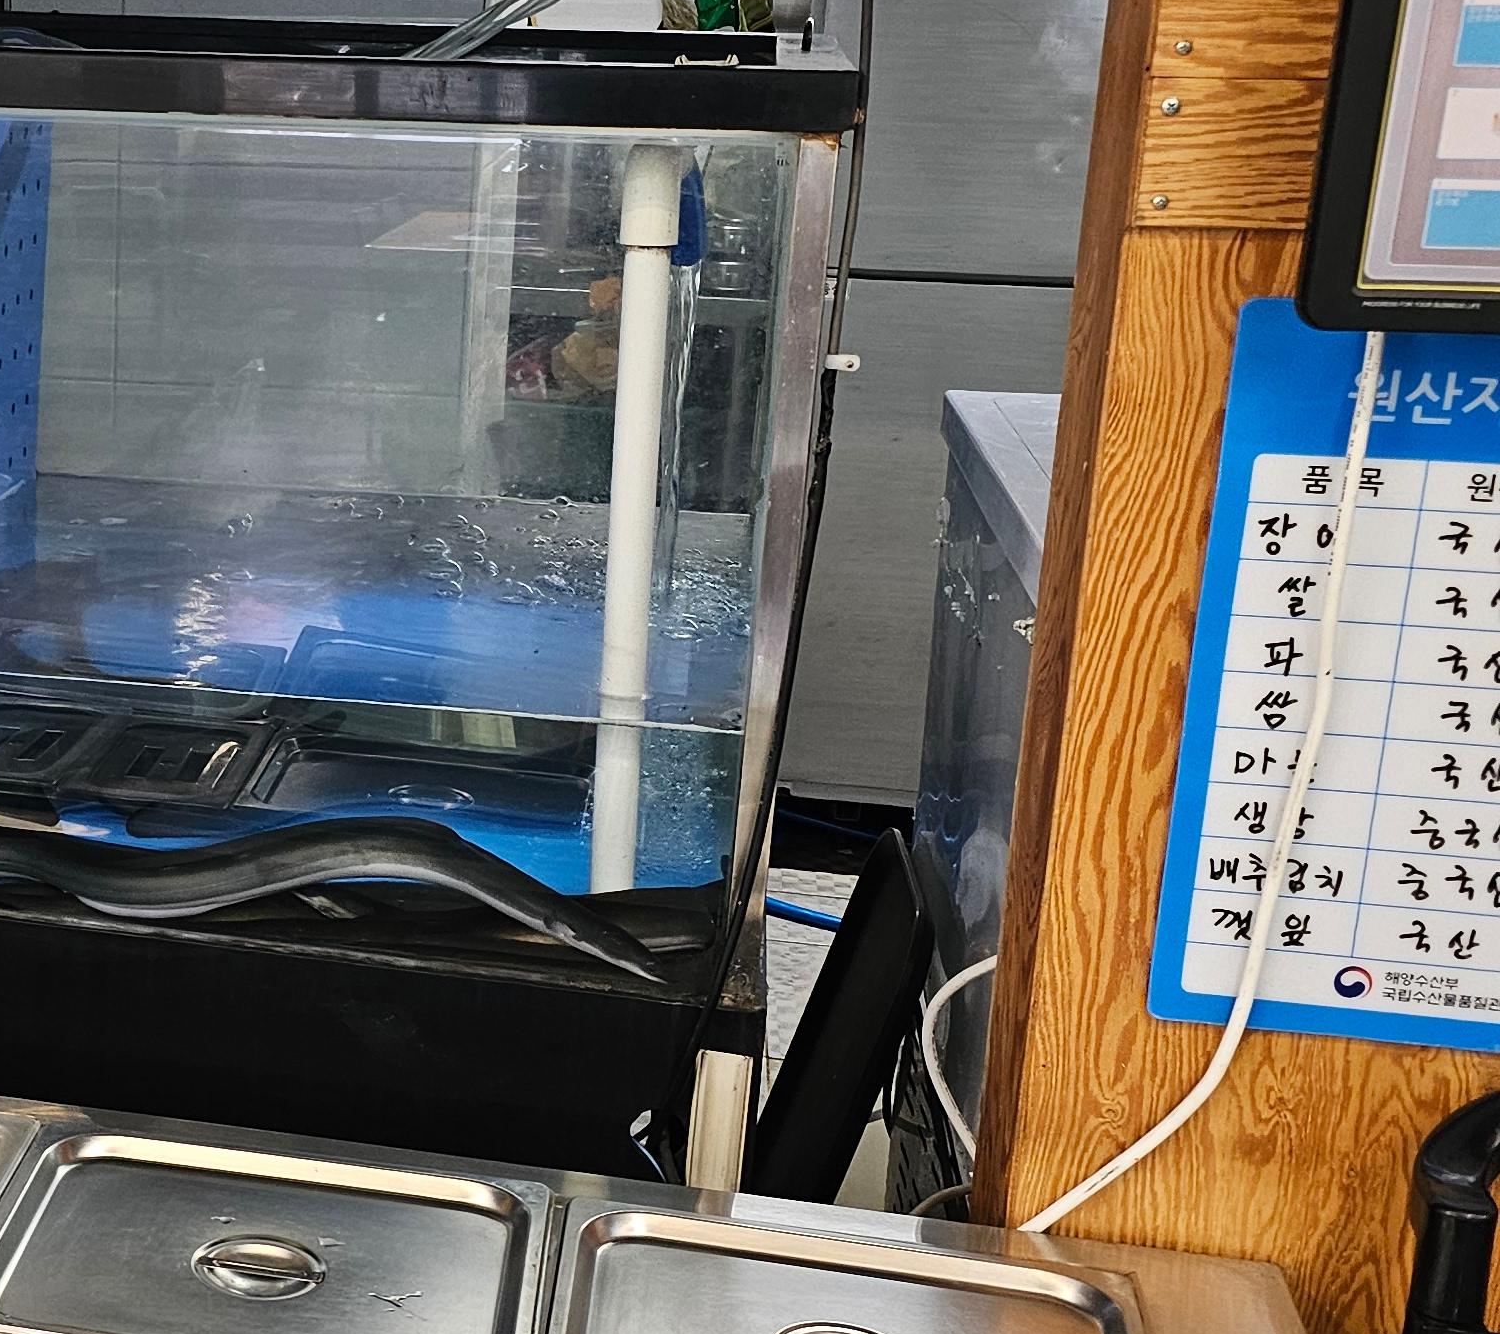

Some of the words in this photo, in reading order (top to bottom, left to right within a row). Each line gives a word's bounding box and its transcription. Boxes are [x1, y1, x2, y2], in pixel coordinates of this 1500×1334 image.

[1278, 576, 1316, 617] 쌀
[1264, 637, 1303, 676] 파
[1410, 810, 1500, 850] 중국
[1399, 920, 1480, 960] 국산
[1384, 971, 1459, 990] 해양수산부
